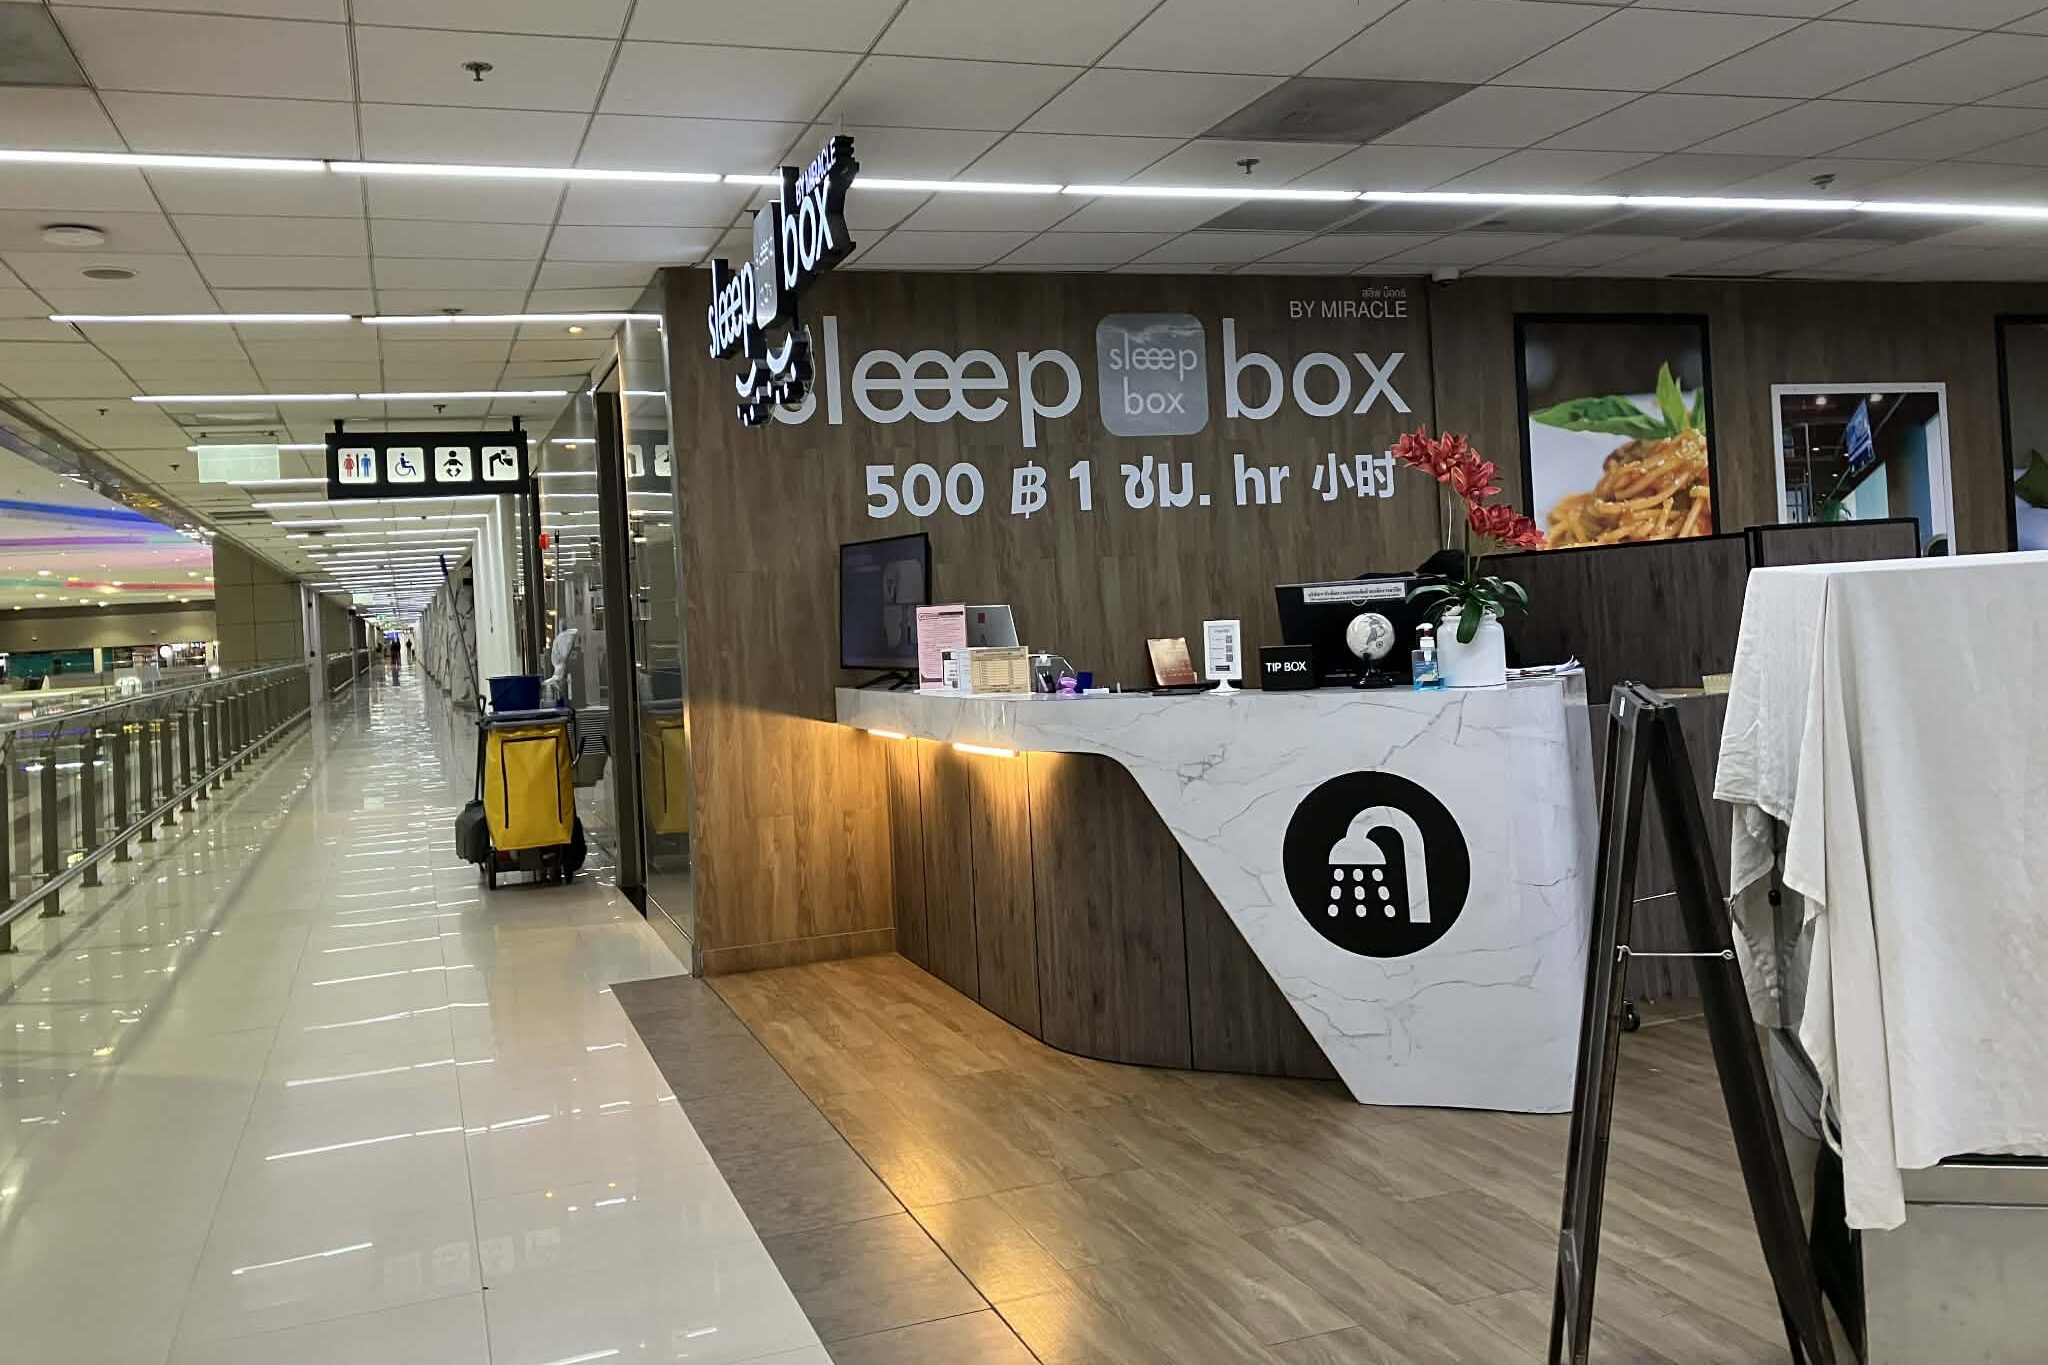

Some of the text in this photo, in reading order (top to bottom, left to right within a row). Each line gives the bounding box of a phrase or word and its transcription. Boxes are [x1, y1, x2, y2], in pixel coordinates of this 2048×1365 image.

[795, 136, 837, 206] BY MIRACLE
[779, 167, 835, 291] box
[1289, 300, 1409, 319] BY MIRACLE
[1123, 375, 1186, 415] box
[1222, 317, 1412, 420] box
[864, 462, 985, 519] 500
[1069, 460, 1092, 511] 1
[1120, 454, 1211, 509] ชม.
[1233, 453, 1290, 506] hr
[1311, 450, 1398, 502] 小时
[1265, 661, 1308, 673] TIP BOX
